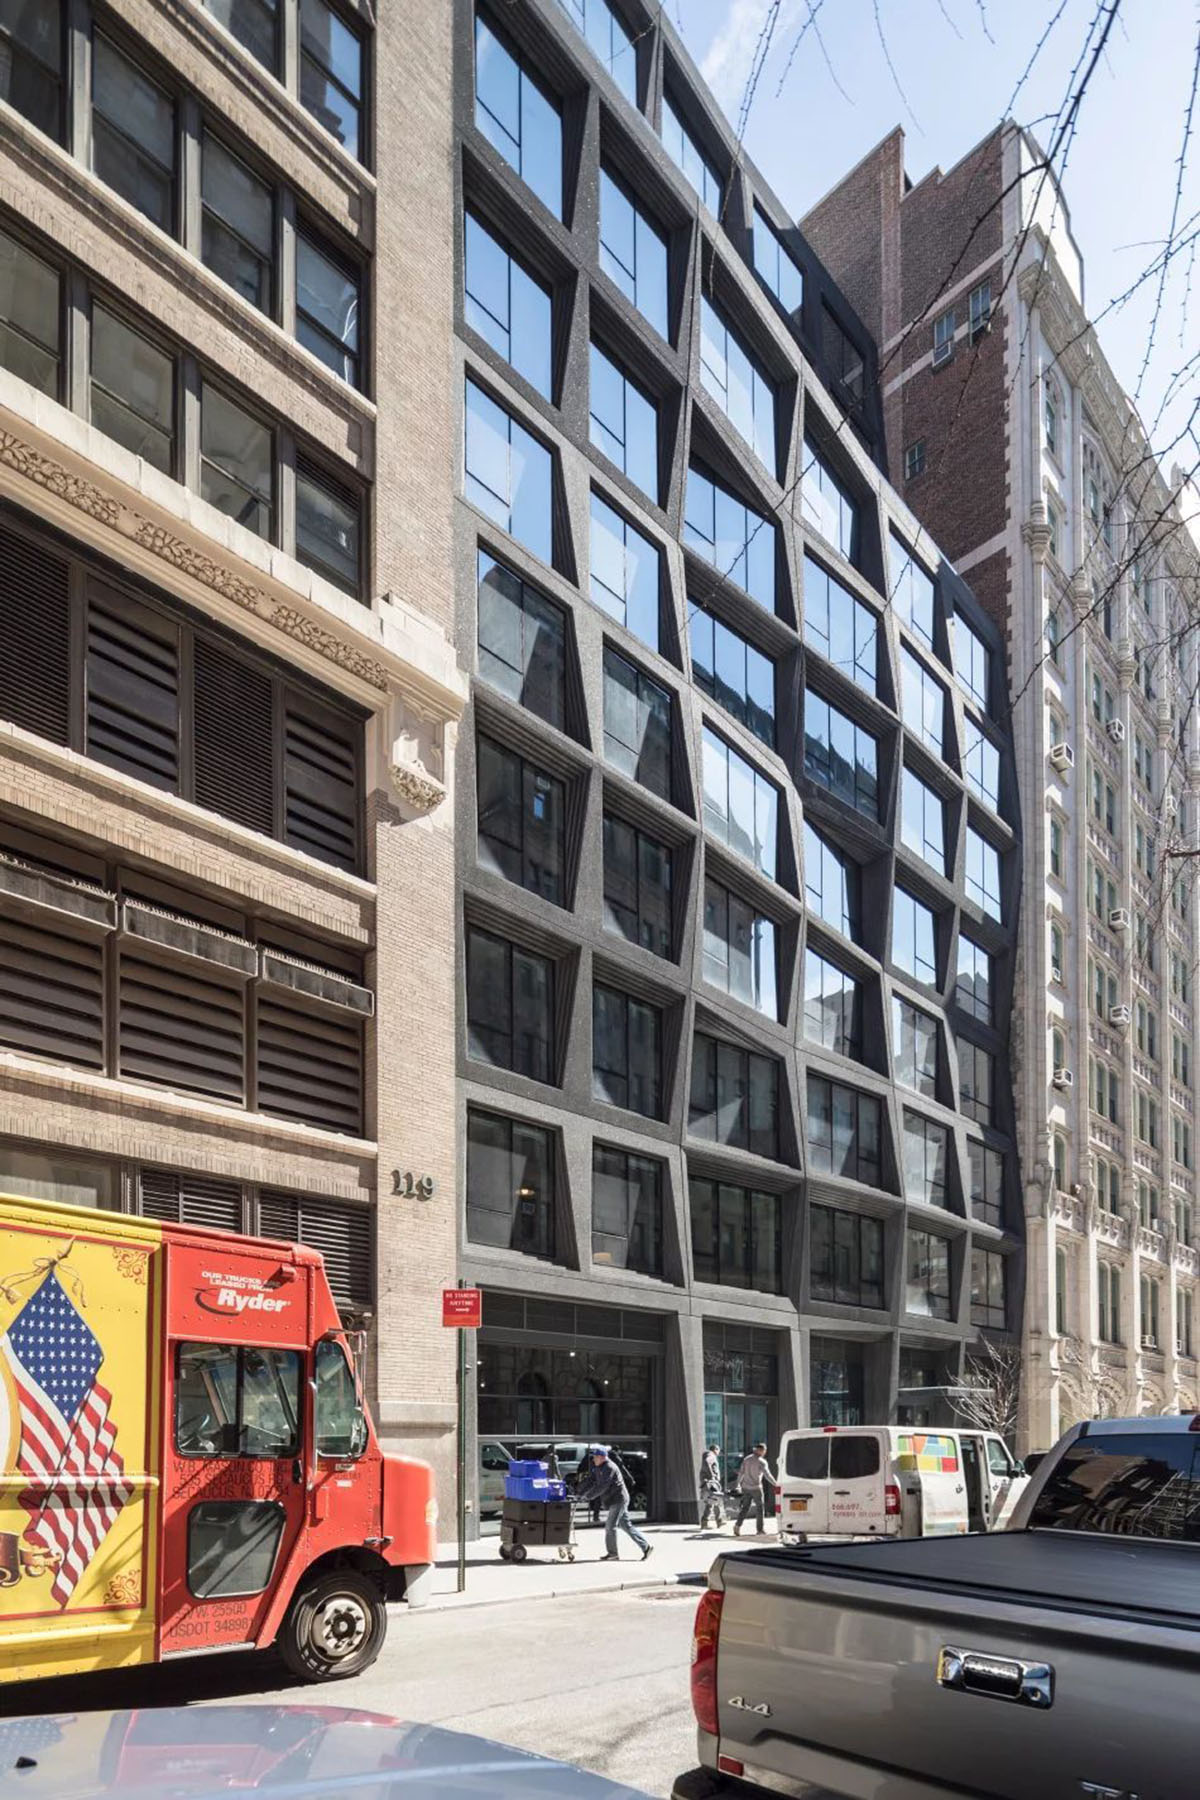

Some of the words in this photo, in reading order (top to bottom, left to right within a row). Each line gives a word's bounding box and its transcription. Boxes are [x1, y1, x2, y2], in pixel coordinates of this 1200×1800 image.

[390, 1168, 435, 1202] 119
[202, 1271, 222, 1280] OUR
[224, 1274, 261, 1285] TRUCKS
[210, 1278, 246, 1289] LEASED
[247, 1283, 274, 1293] FROM
[217, 1288, 288, 1312] Ryder
[170, 1620, 211, 1638] USDOT
